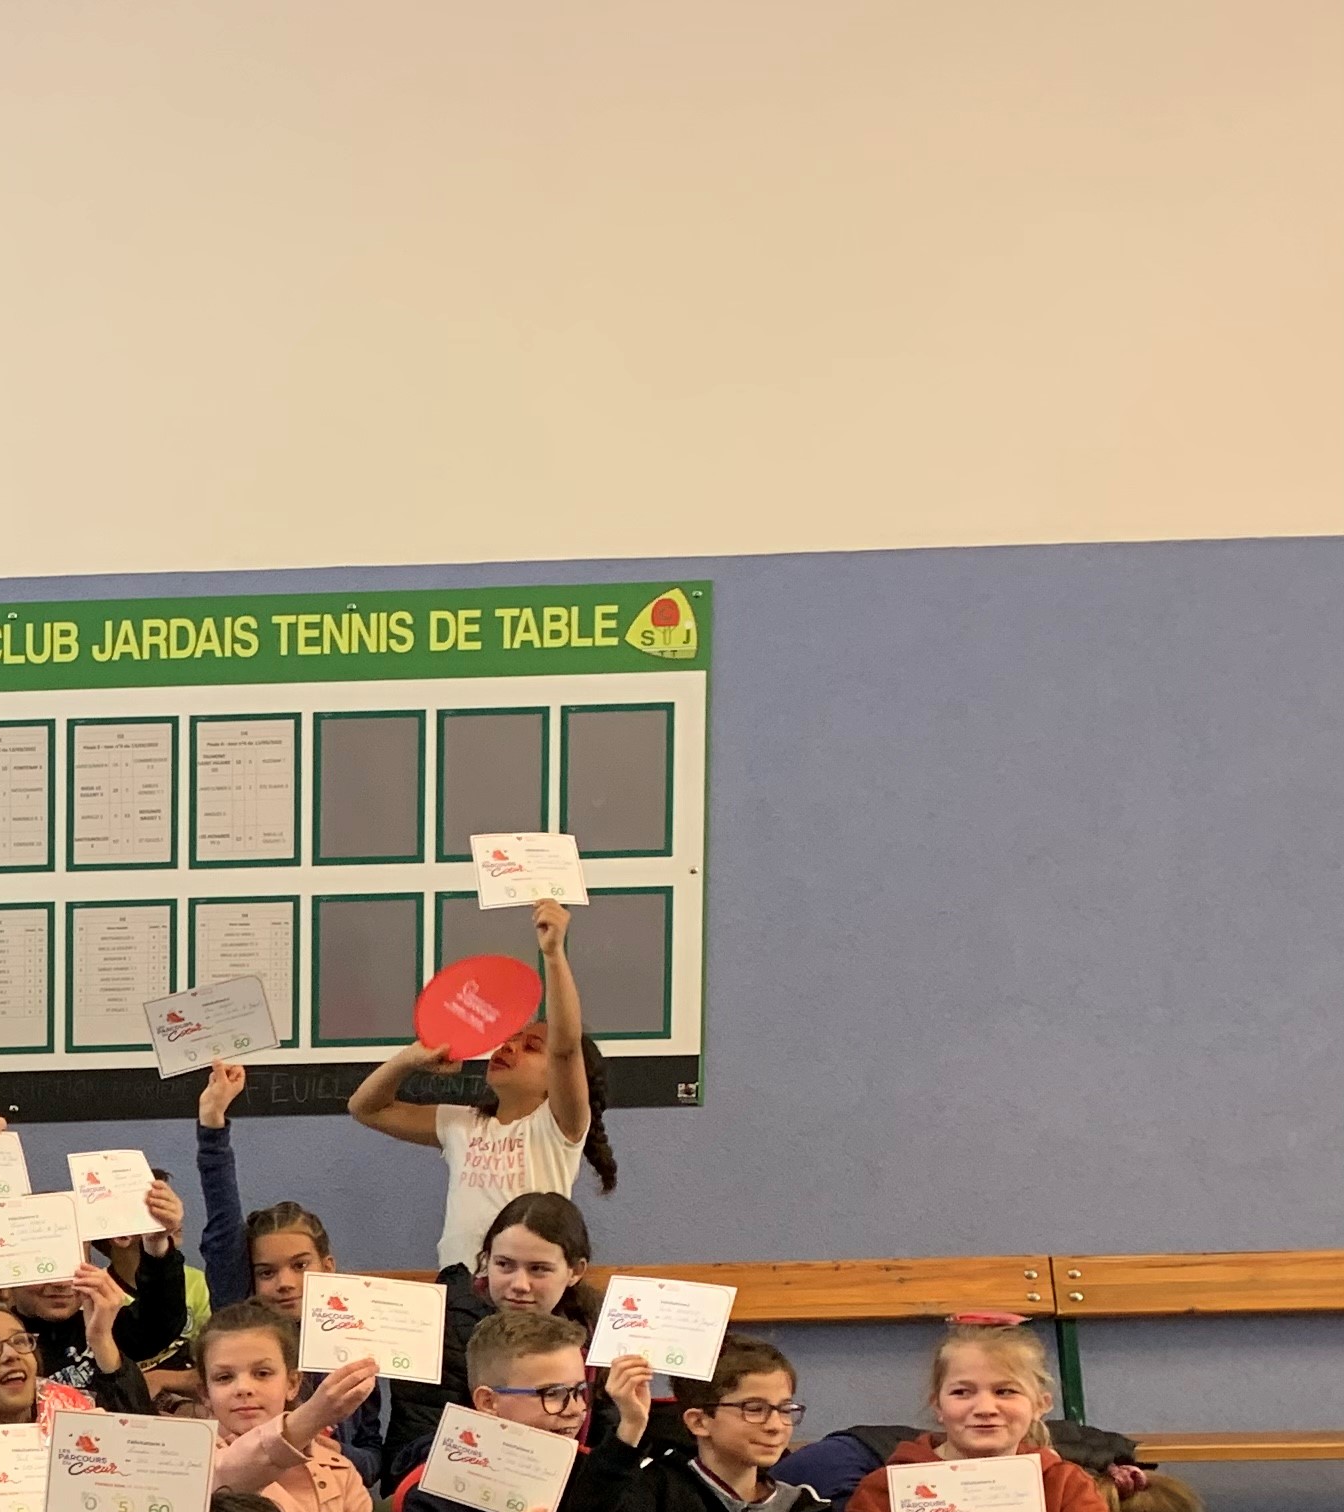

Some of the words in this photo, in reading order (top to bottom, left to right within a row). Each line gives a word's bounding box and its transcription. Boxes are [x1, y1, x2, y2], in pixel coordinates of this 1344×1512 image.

[93, 616, 259, 663] JARDAIS
[272, 610, 414, 656] TENNIS
[429, 609, 472, 652] DE
[494, 605, 620, 650] TABLE
[550, 886, 564, 896] 60
[233, 1036, 250, 1049] 60
[36, 1262, 55, 1275] 60
[391, 1356, 410, 1369] 60
[665, 1353, 684, 1366] 60
[58, 1452, 108, 1464] PARCOURS
[506, 1498, 524, 1512] 60
